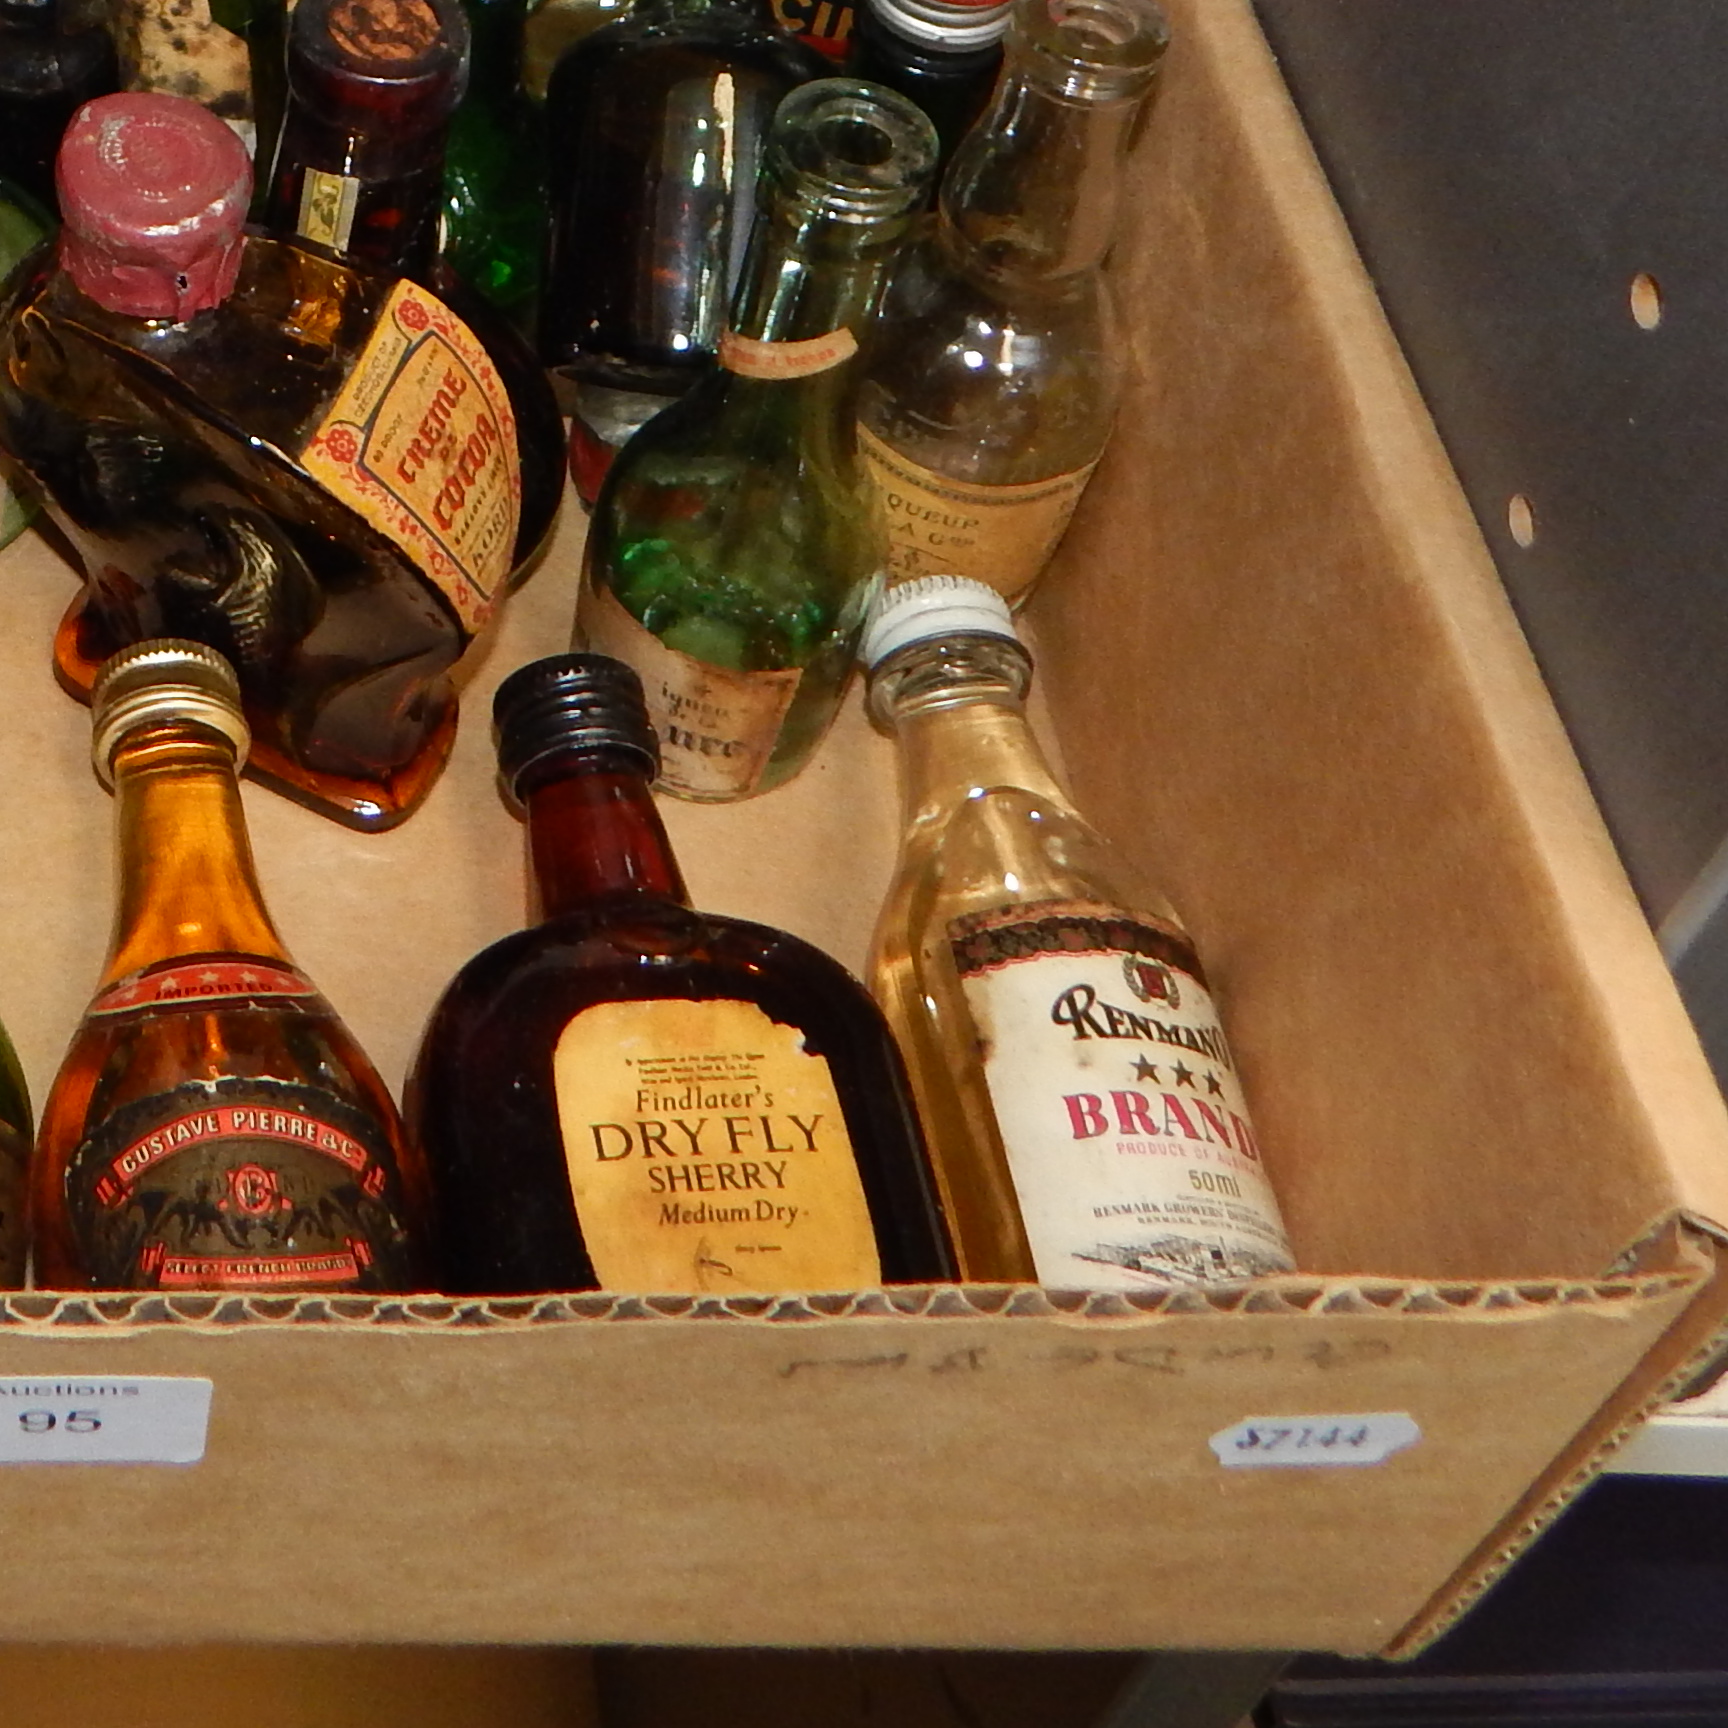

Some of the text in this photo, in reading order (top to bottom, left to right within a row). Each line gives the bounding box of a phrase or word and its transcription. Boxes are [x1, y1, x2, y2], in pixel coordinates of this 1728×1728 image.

[396, 367, 467, 484] CREME
[432, 412, 497, 532] COCOA
[636, 1083, 775, 1113] Findlater's
[121, 1114, 220, 1174] GUSTAVE
[232, 1109, 318, 1143] PIERRE
[588, 1113, 825, 1162] DRY FLY
[647, 1160, 788, 1194] SHERRY
[1187, 1167, 1243, 1200] 50ml
[658, 1198, 800, 1230] Medium Dry
[17, 1408, 103, 1435] 95
